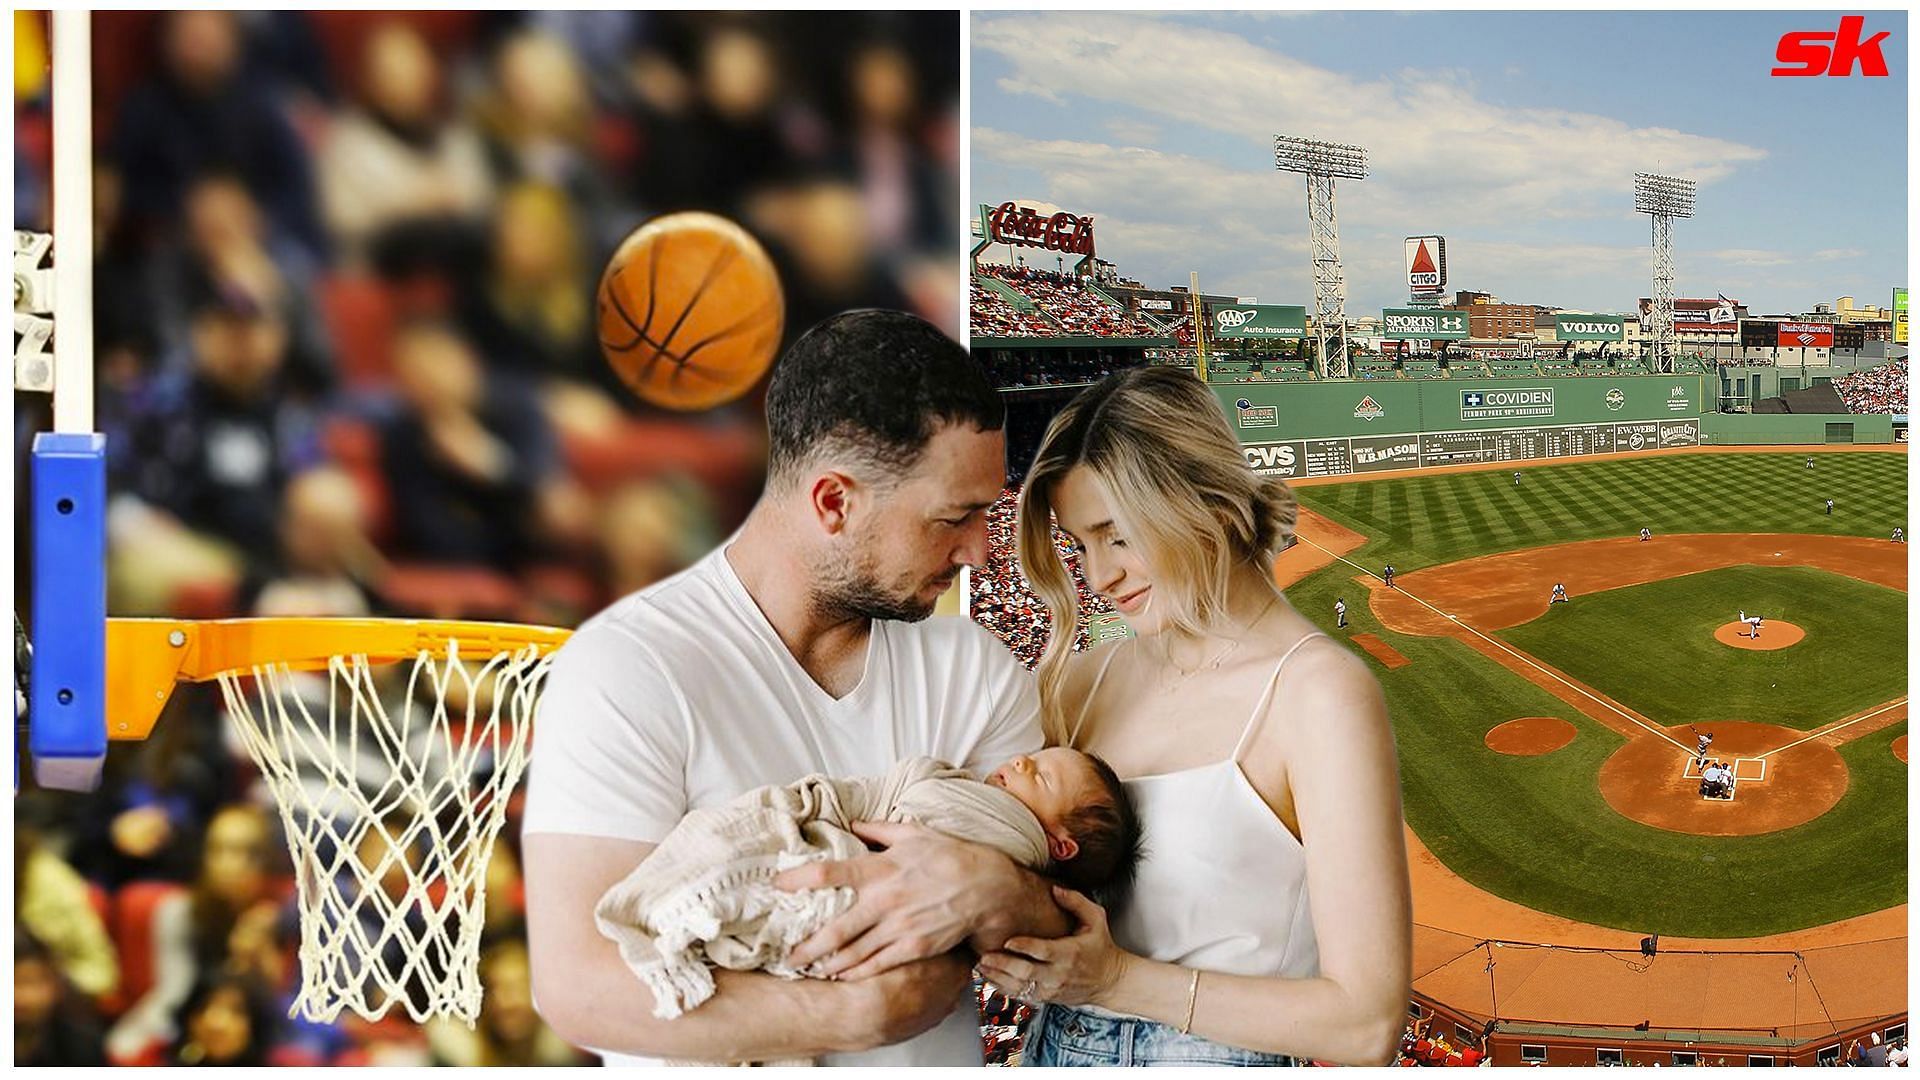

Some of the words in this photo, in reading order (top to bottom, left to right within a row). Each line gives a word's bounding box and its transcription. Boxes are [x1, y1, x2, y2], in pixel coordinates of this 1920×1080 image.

[1410, 273, 1437, 285] CITGO
[1220, 311, 1243, 326] AAA
[1385, 315, 1435, 327] SPORTS
[1243, 326, 1264, 334] Auto
[1265, 326, 1304, 334] Insurance
[1560, 321, 1620, 334] VOLVO
[1486, 391, 1552, 405] COVIDIEN
[1243, 445, 1296, 468] CVS
